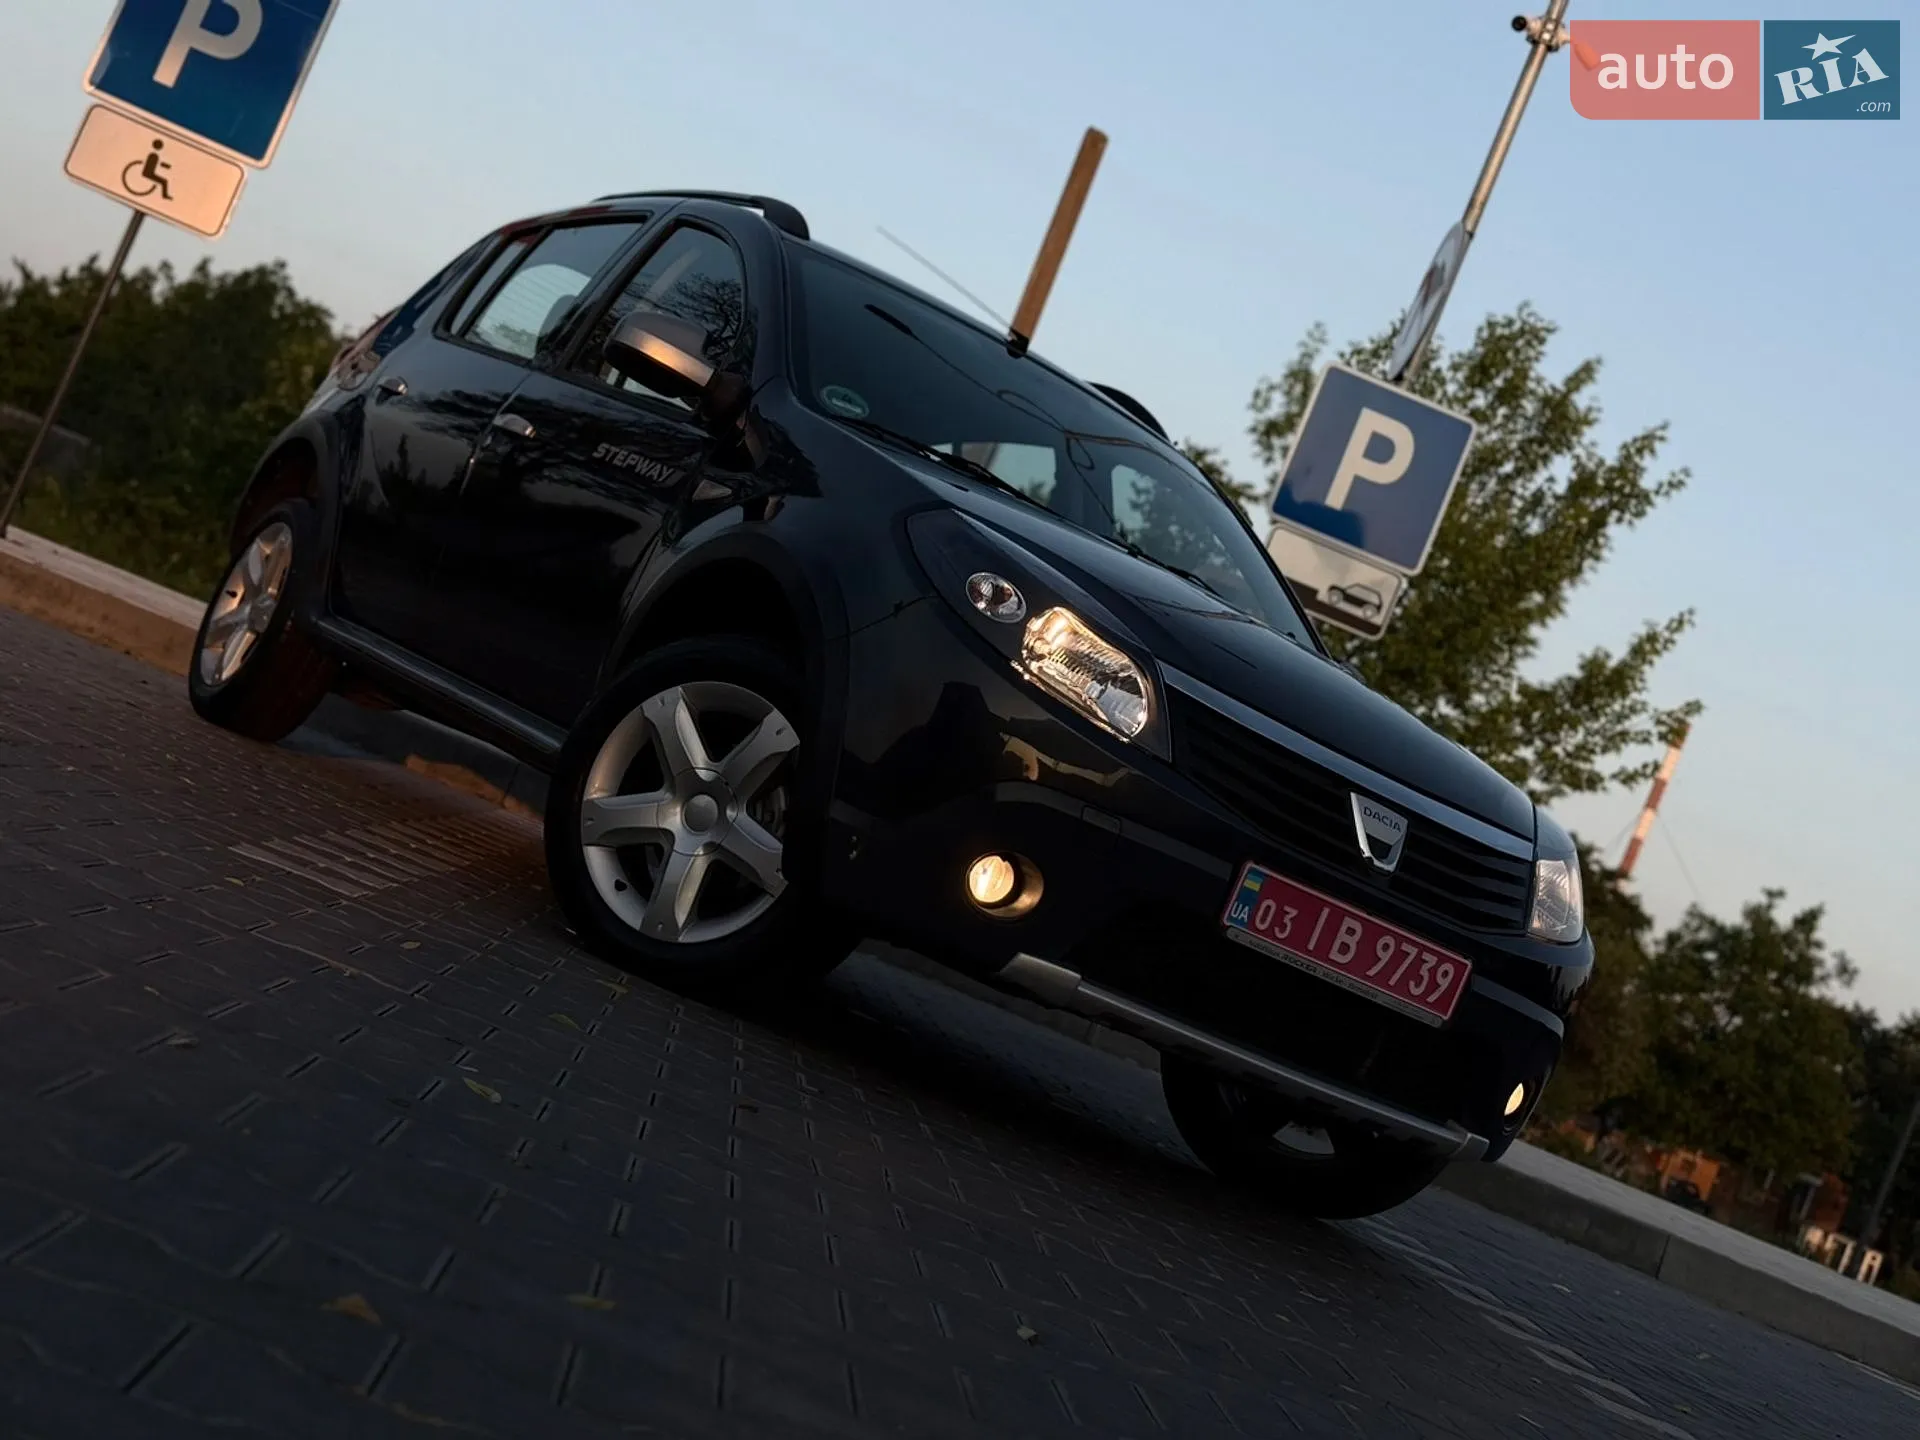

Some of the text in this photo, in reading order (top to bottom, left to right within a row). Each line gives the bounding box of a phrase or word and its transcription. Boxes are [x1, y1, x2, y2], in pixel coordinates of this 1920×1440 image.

[153, 0, 263, 88] P
[591, 441, 676, 483] STEPWAY
[1324, 407, 1415, 511] P
[1362, 805, 1402, 833] DACIA
[1230, 901, 1251, 923] UA
[1254, 899, 1299, 939] 03
[1307, 906, 1364, 965] IB
[1366, 935, 1455, 1004] 9739
